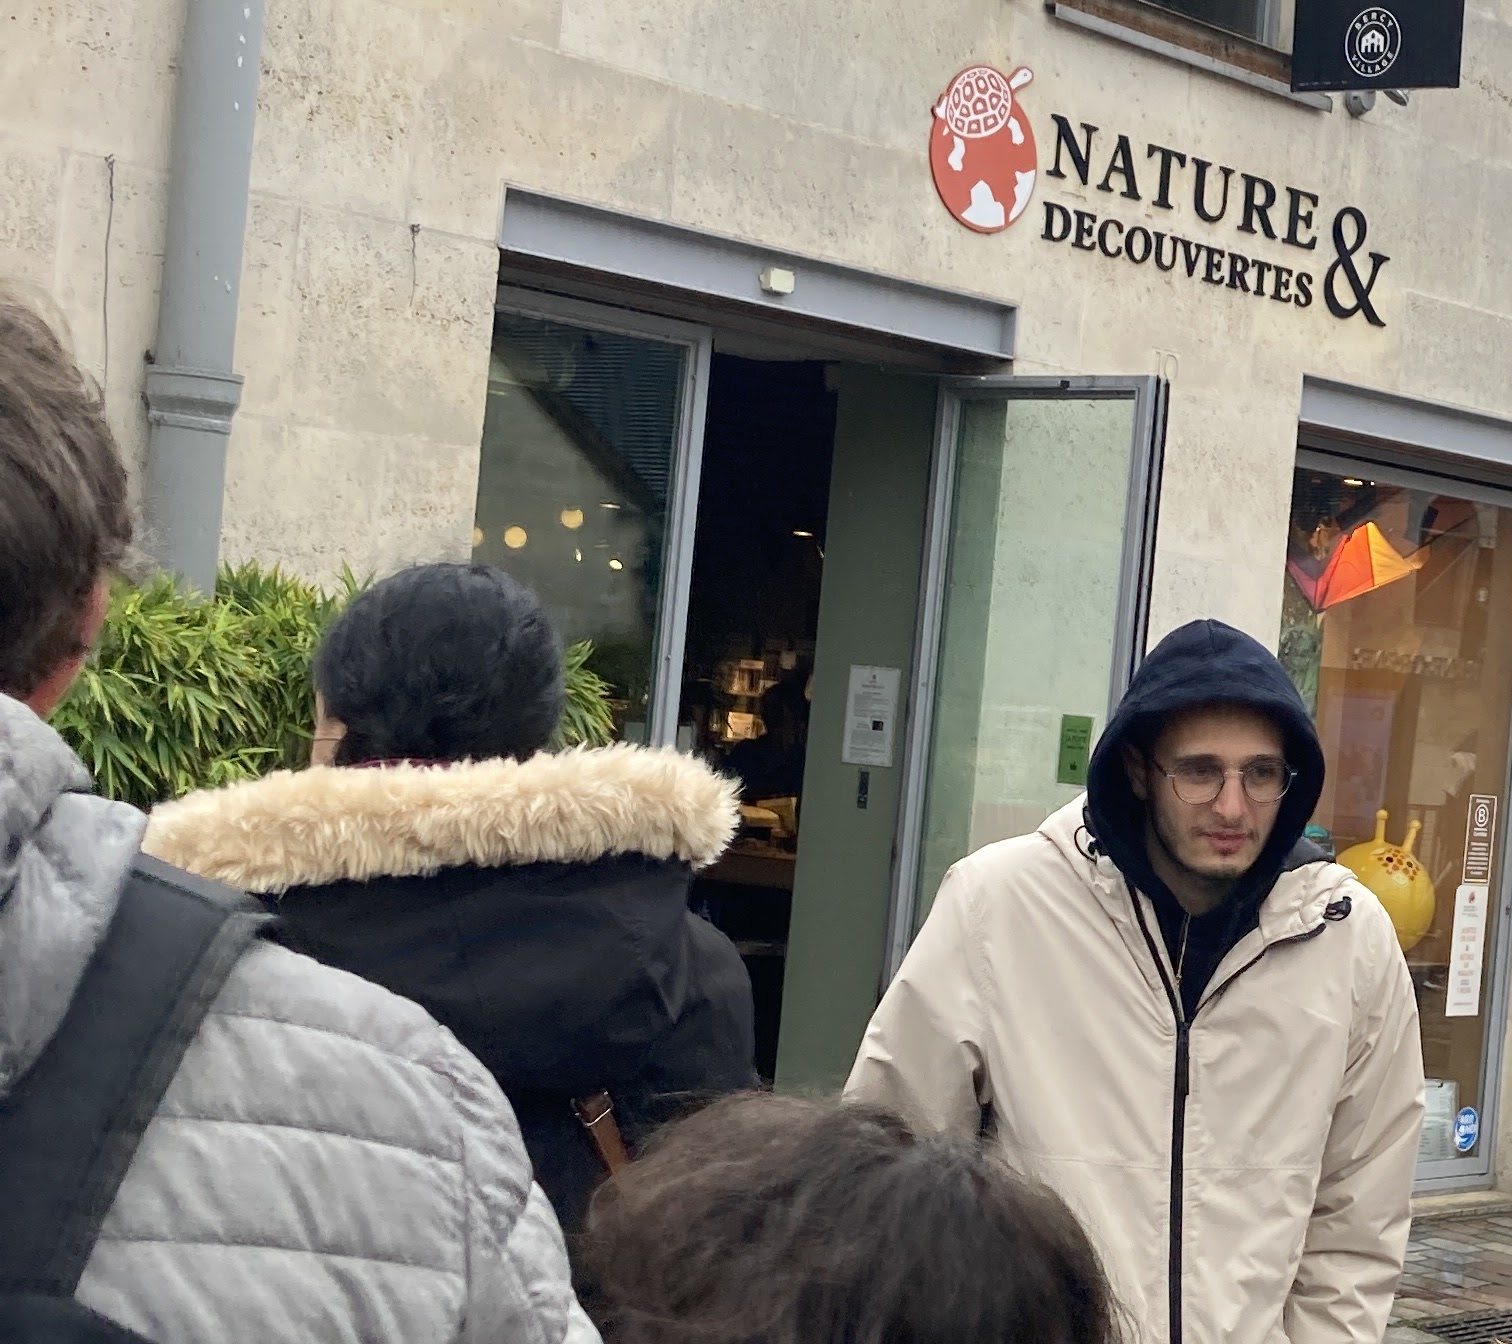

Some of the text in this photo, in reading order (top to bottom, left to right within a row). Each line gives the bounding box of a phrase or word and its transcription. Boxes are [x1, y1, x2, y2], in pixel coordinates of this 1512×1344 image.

[1354, 11, 1394, 31] BERCY
[1351, 50, 1394, 74] VILLAGE
[1045, 113, 1391, 328] NATURE &
[1041, 201, 1313, 308] DECOUVERTES
